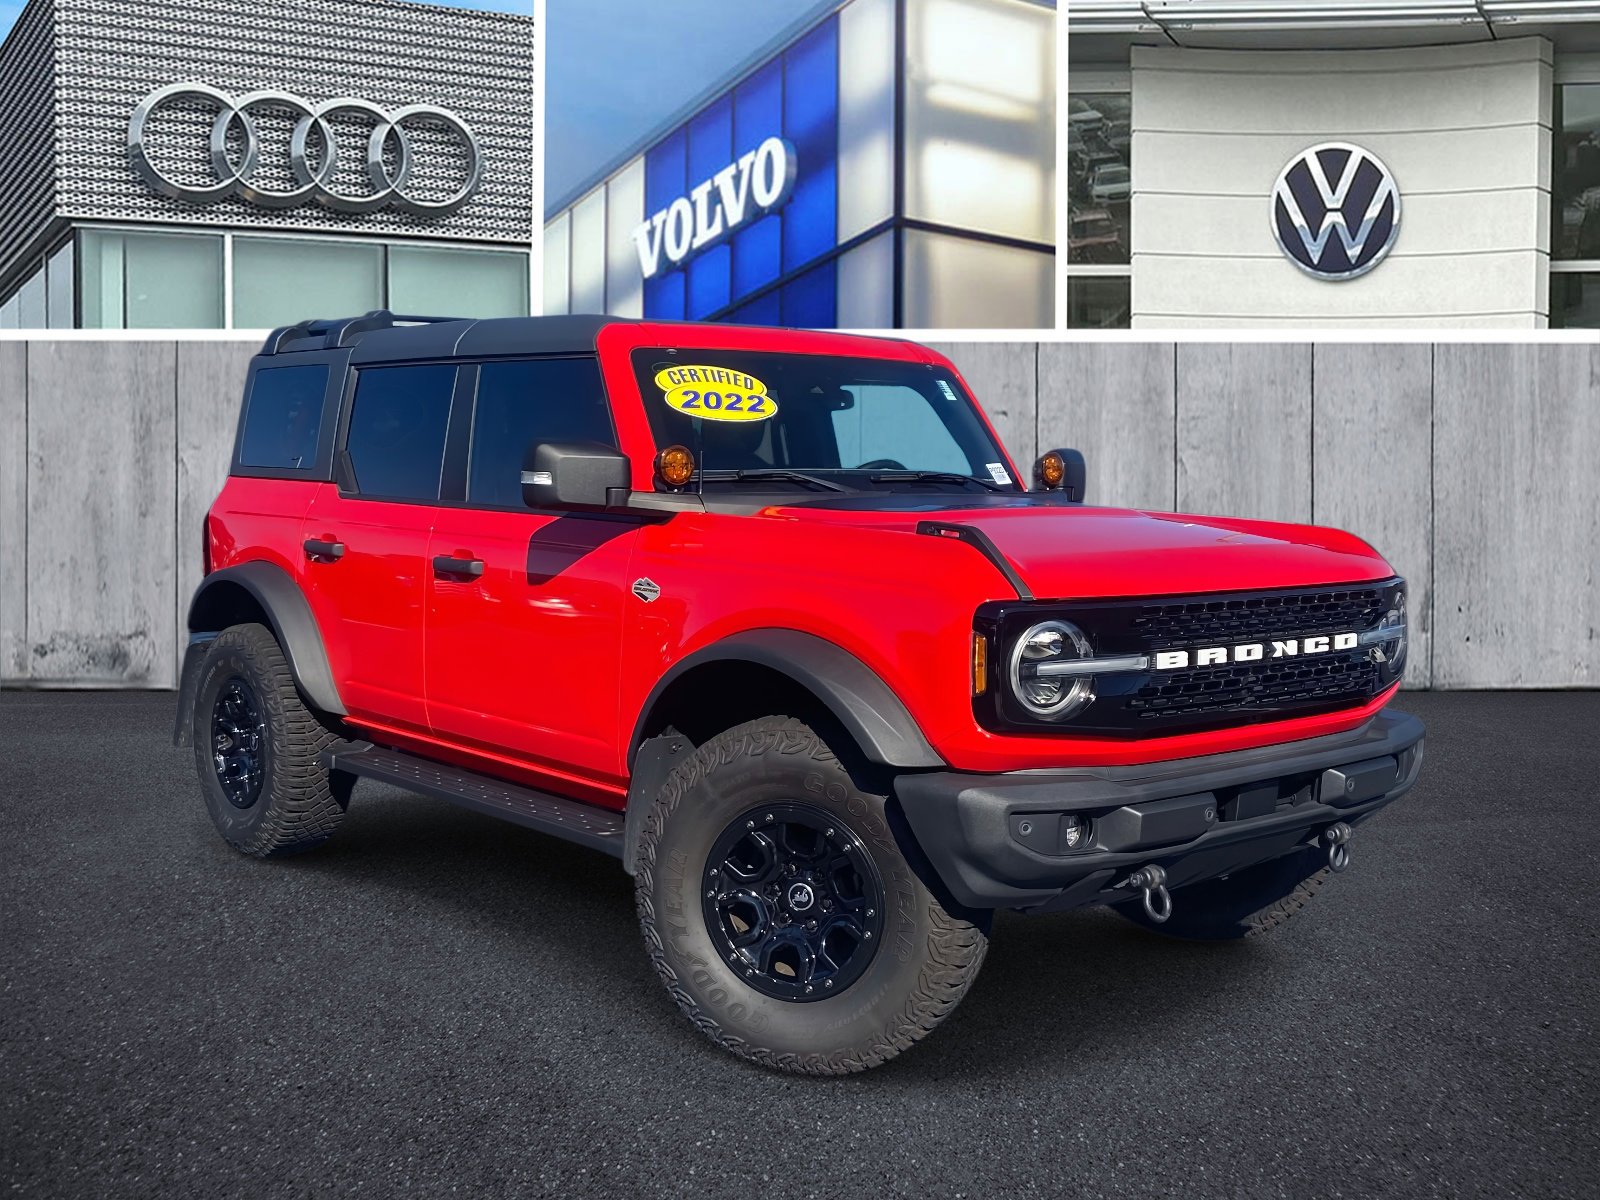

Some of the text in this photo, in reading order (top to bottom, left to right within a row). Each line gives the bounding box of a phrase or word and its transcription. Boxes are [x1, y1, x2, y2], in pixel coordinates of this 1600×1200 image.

[631, 136, 787, 279] VOLVO
[667, 368, 754, 391] CERTIFIED
[681, 390, 766, 413] 2022
[1156, 632, 1358, 670] BRONCO
